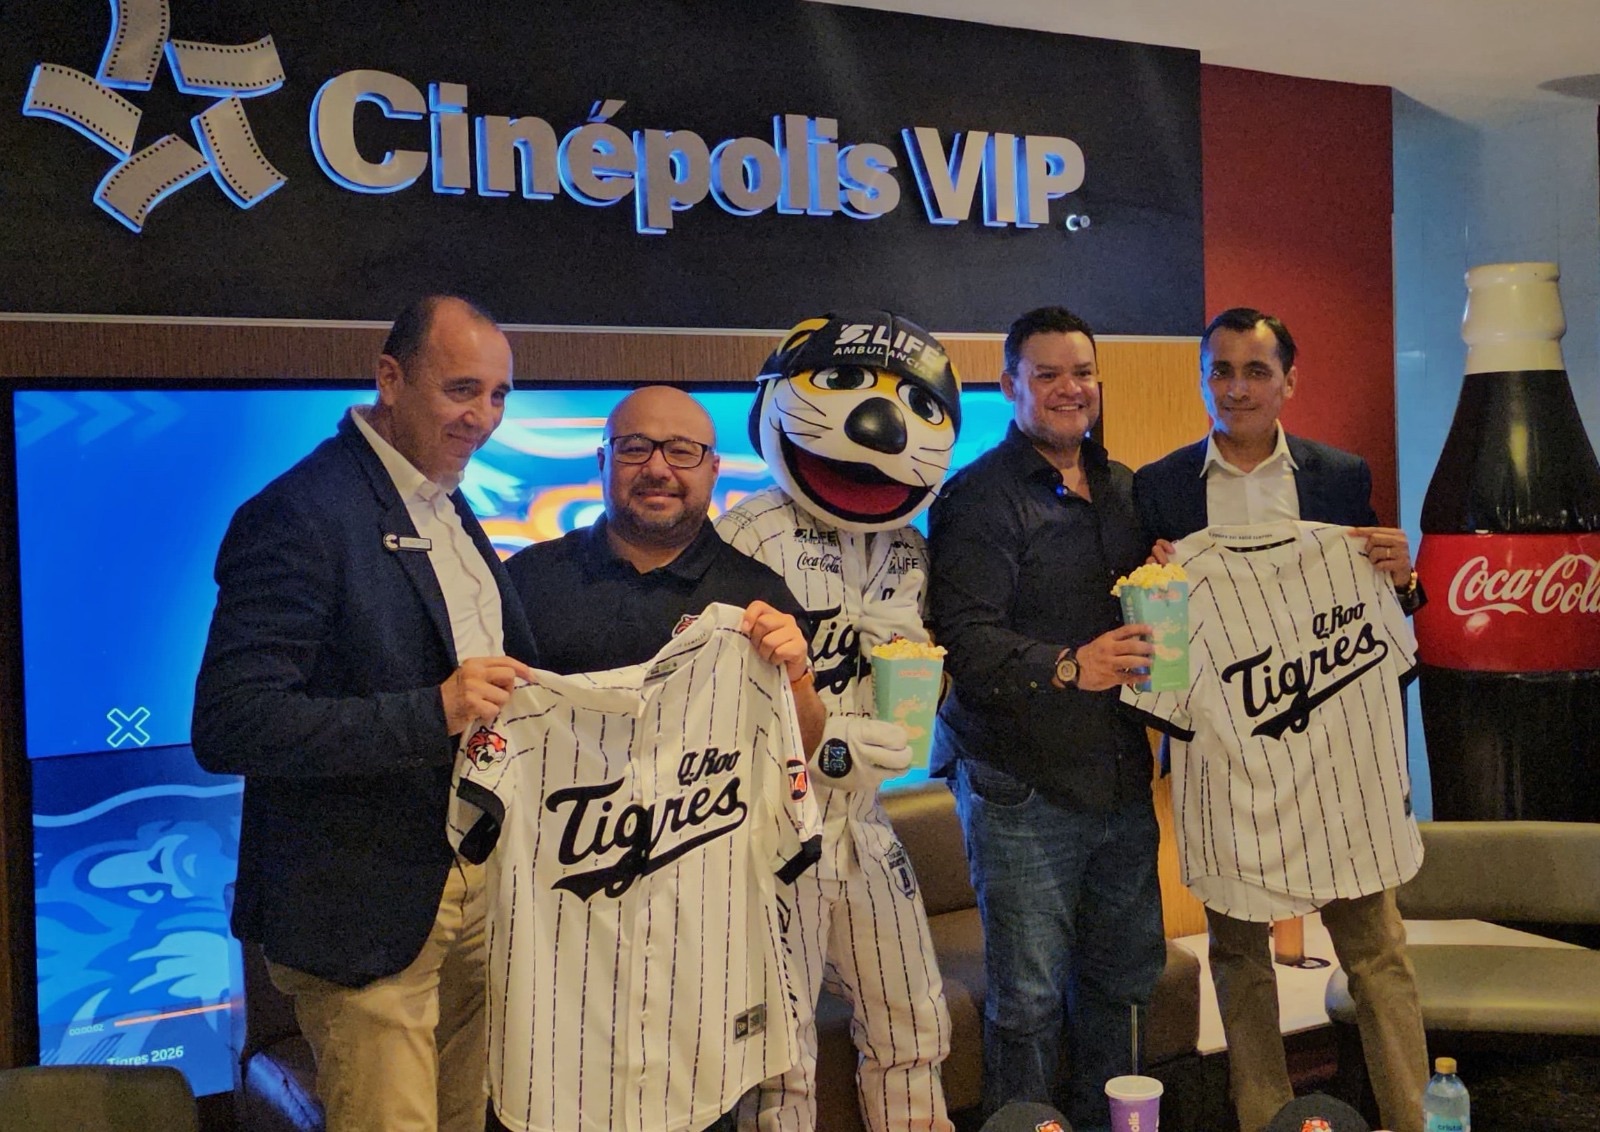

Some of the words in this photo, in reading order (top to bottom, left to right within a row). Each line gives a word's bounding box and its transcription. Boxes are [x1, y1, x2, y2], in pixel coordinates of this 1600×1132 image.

[311, 69, 901, 234] Cinépolis
[902, 126, 1085, 227] VIP
[872, 326, 944, 363] LIFE
[1221, 622, 1389, 741] Tigres
[545, 776, 748, 902] Tigres
[151, 1045, 184, 1063] 2026
